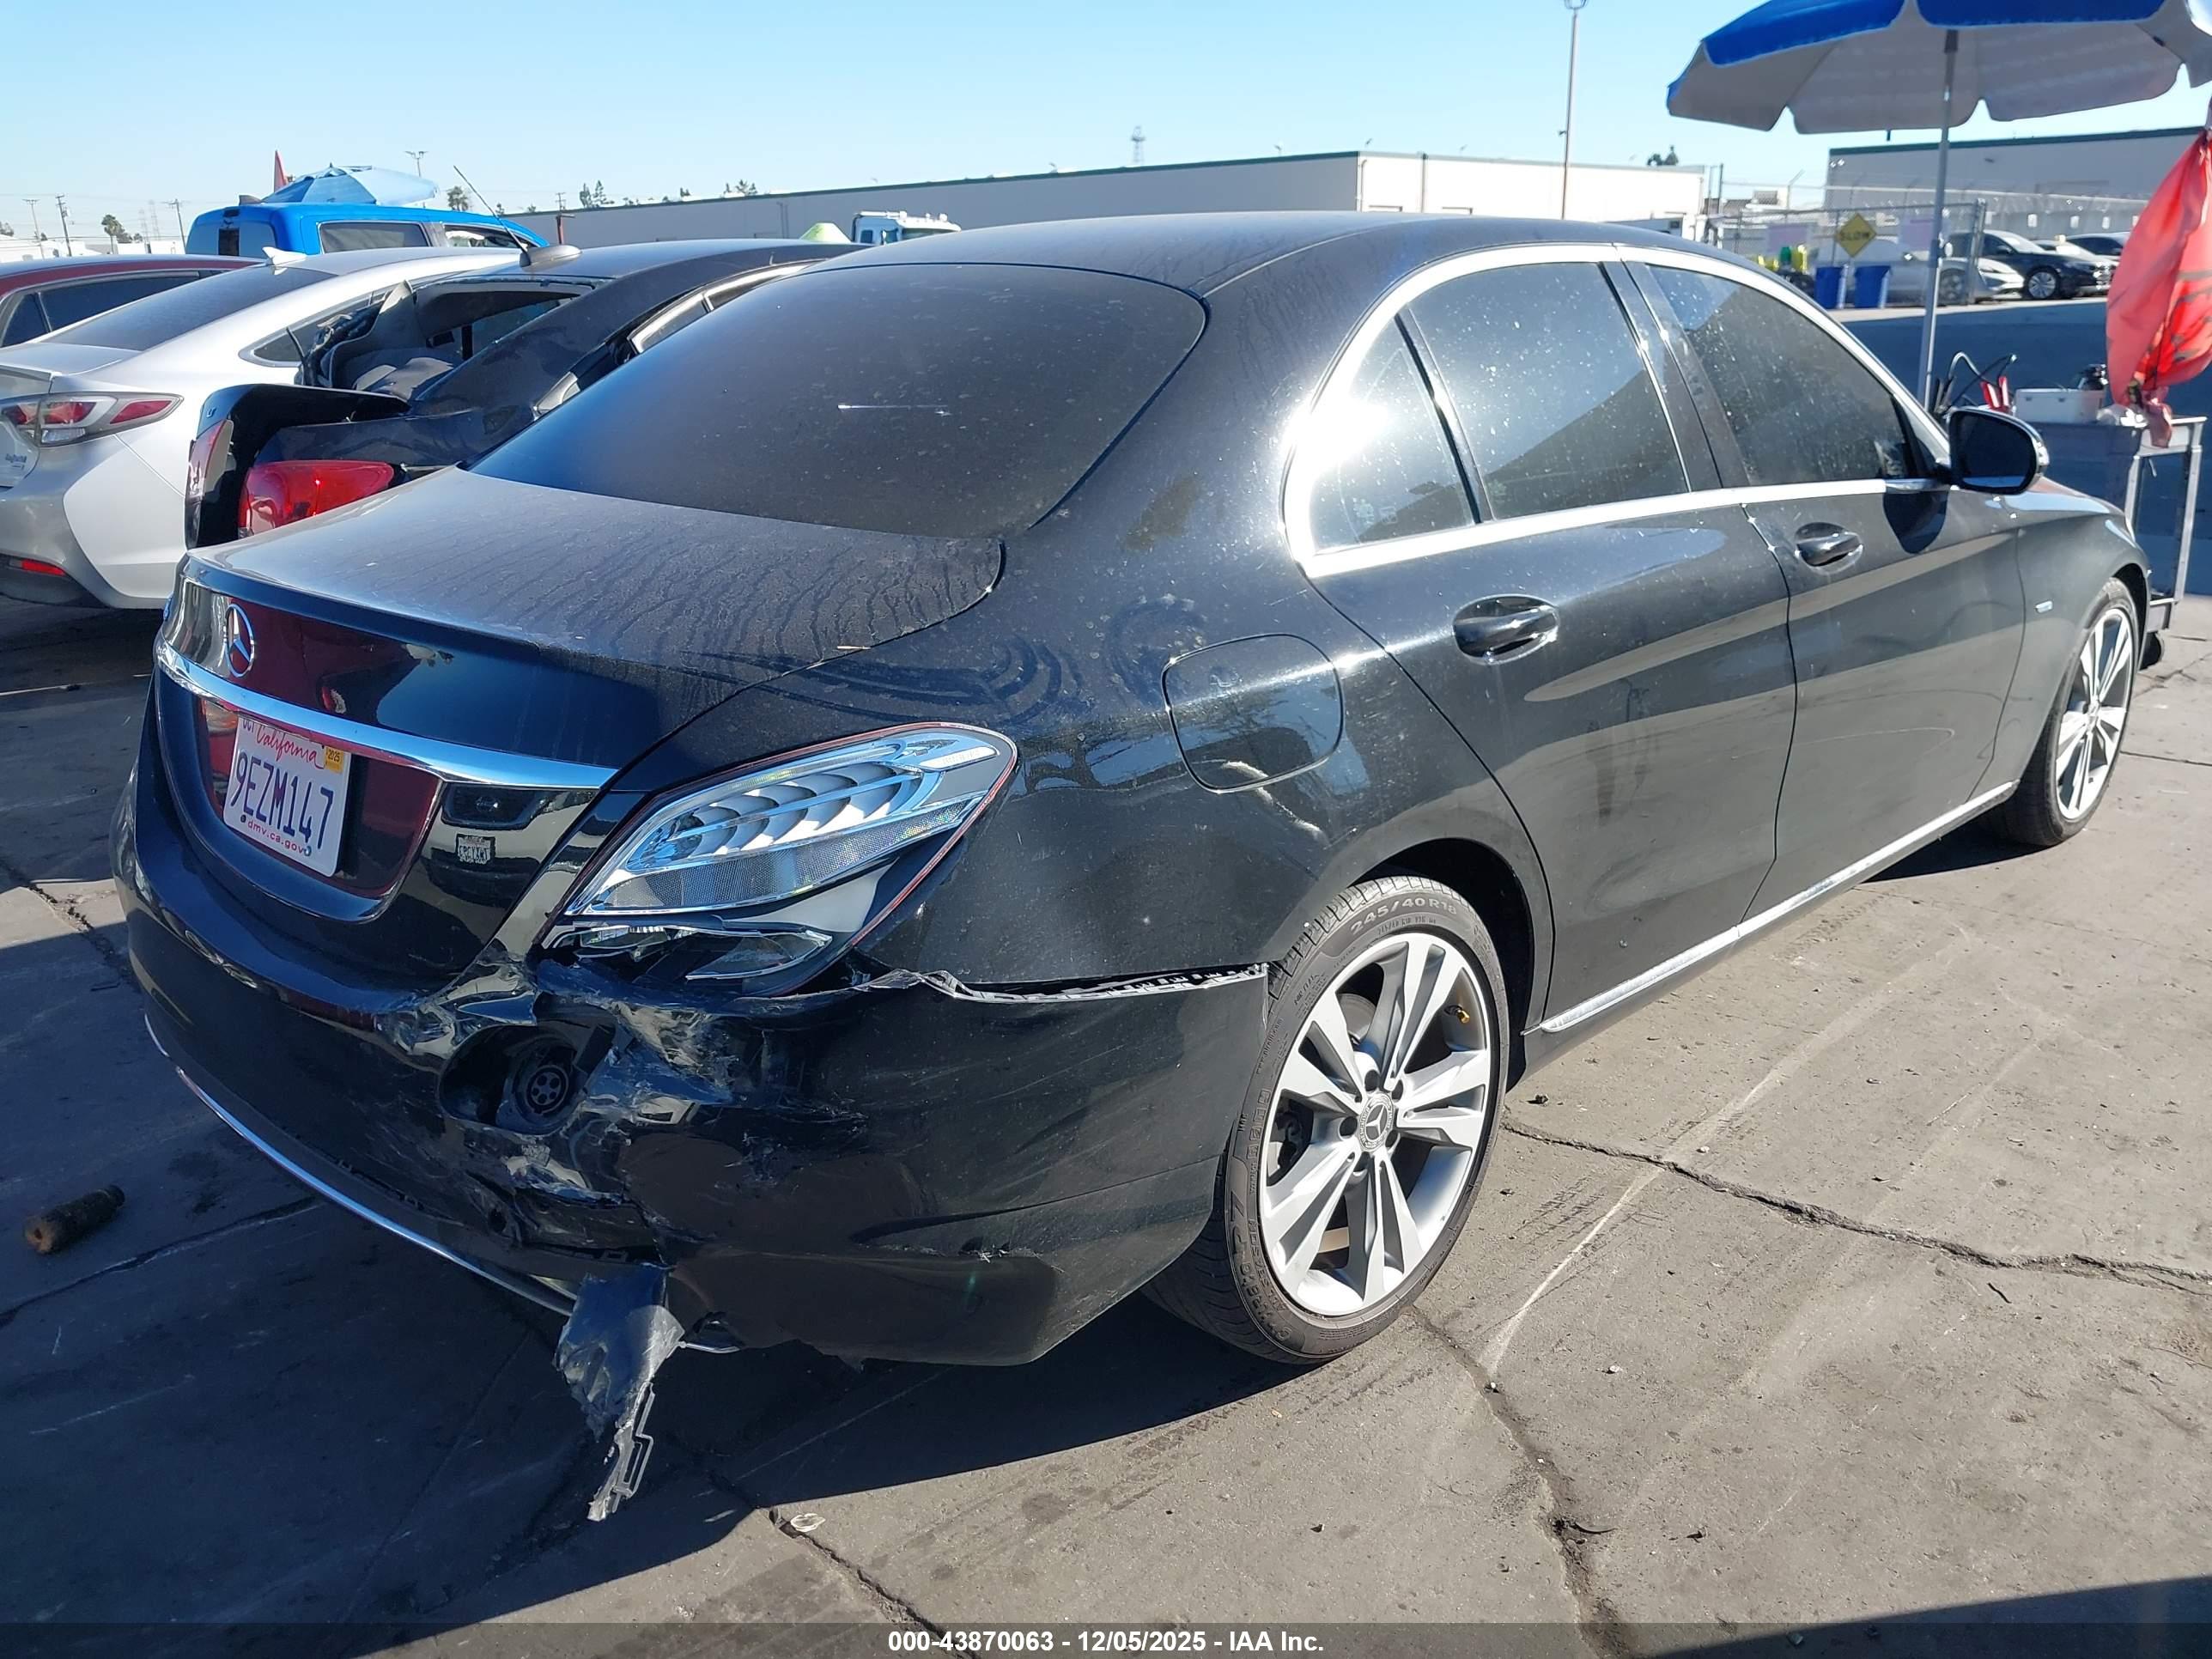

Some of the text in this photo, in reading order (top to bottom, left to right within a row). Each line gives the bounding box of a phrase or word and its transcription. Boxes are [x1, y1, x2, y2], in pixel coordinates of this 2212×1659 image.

[256, 724, 324, 769] California
[230, 751, 334, 849] 9EZM147
[247, 820, 304, 854] dmv.ca.gov
